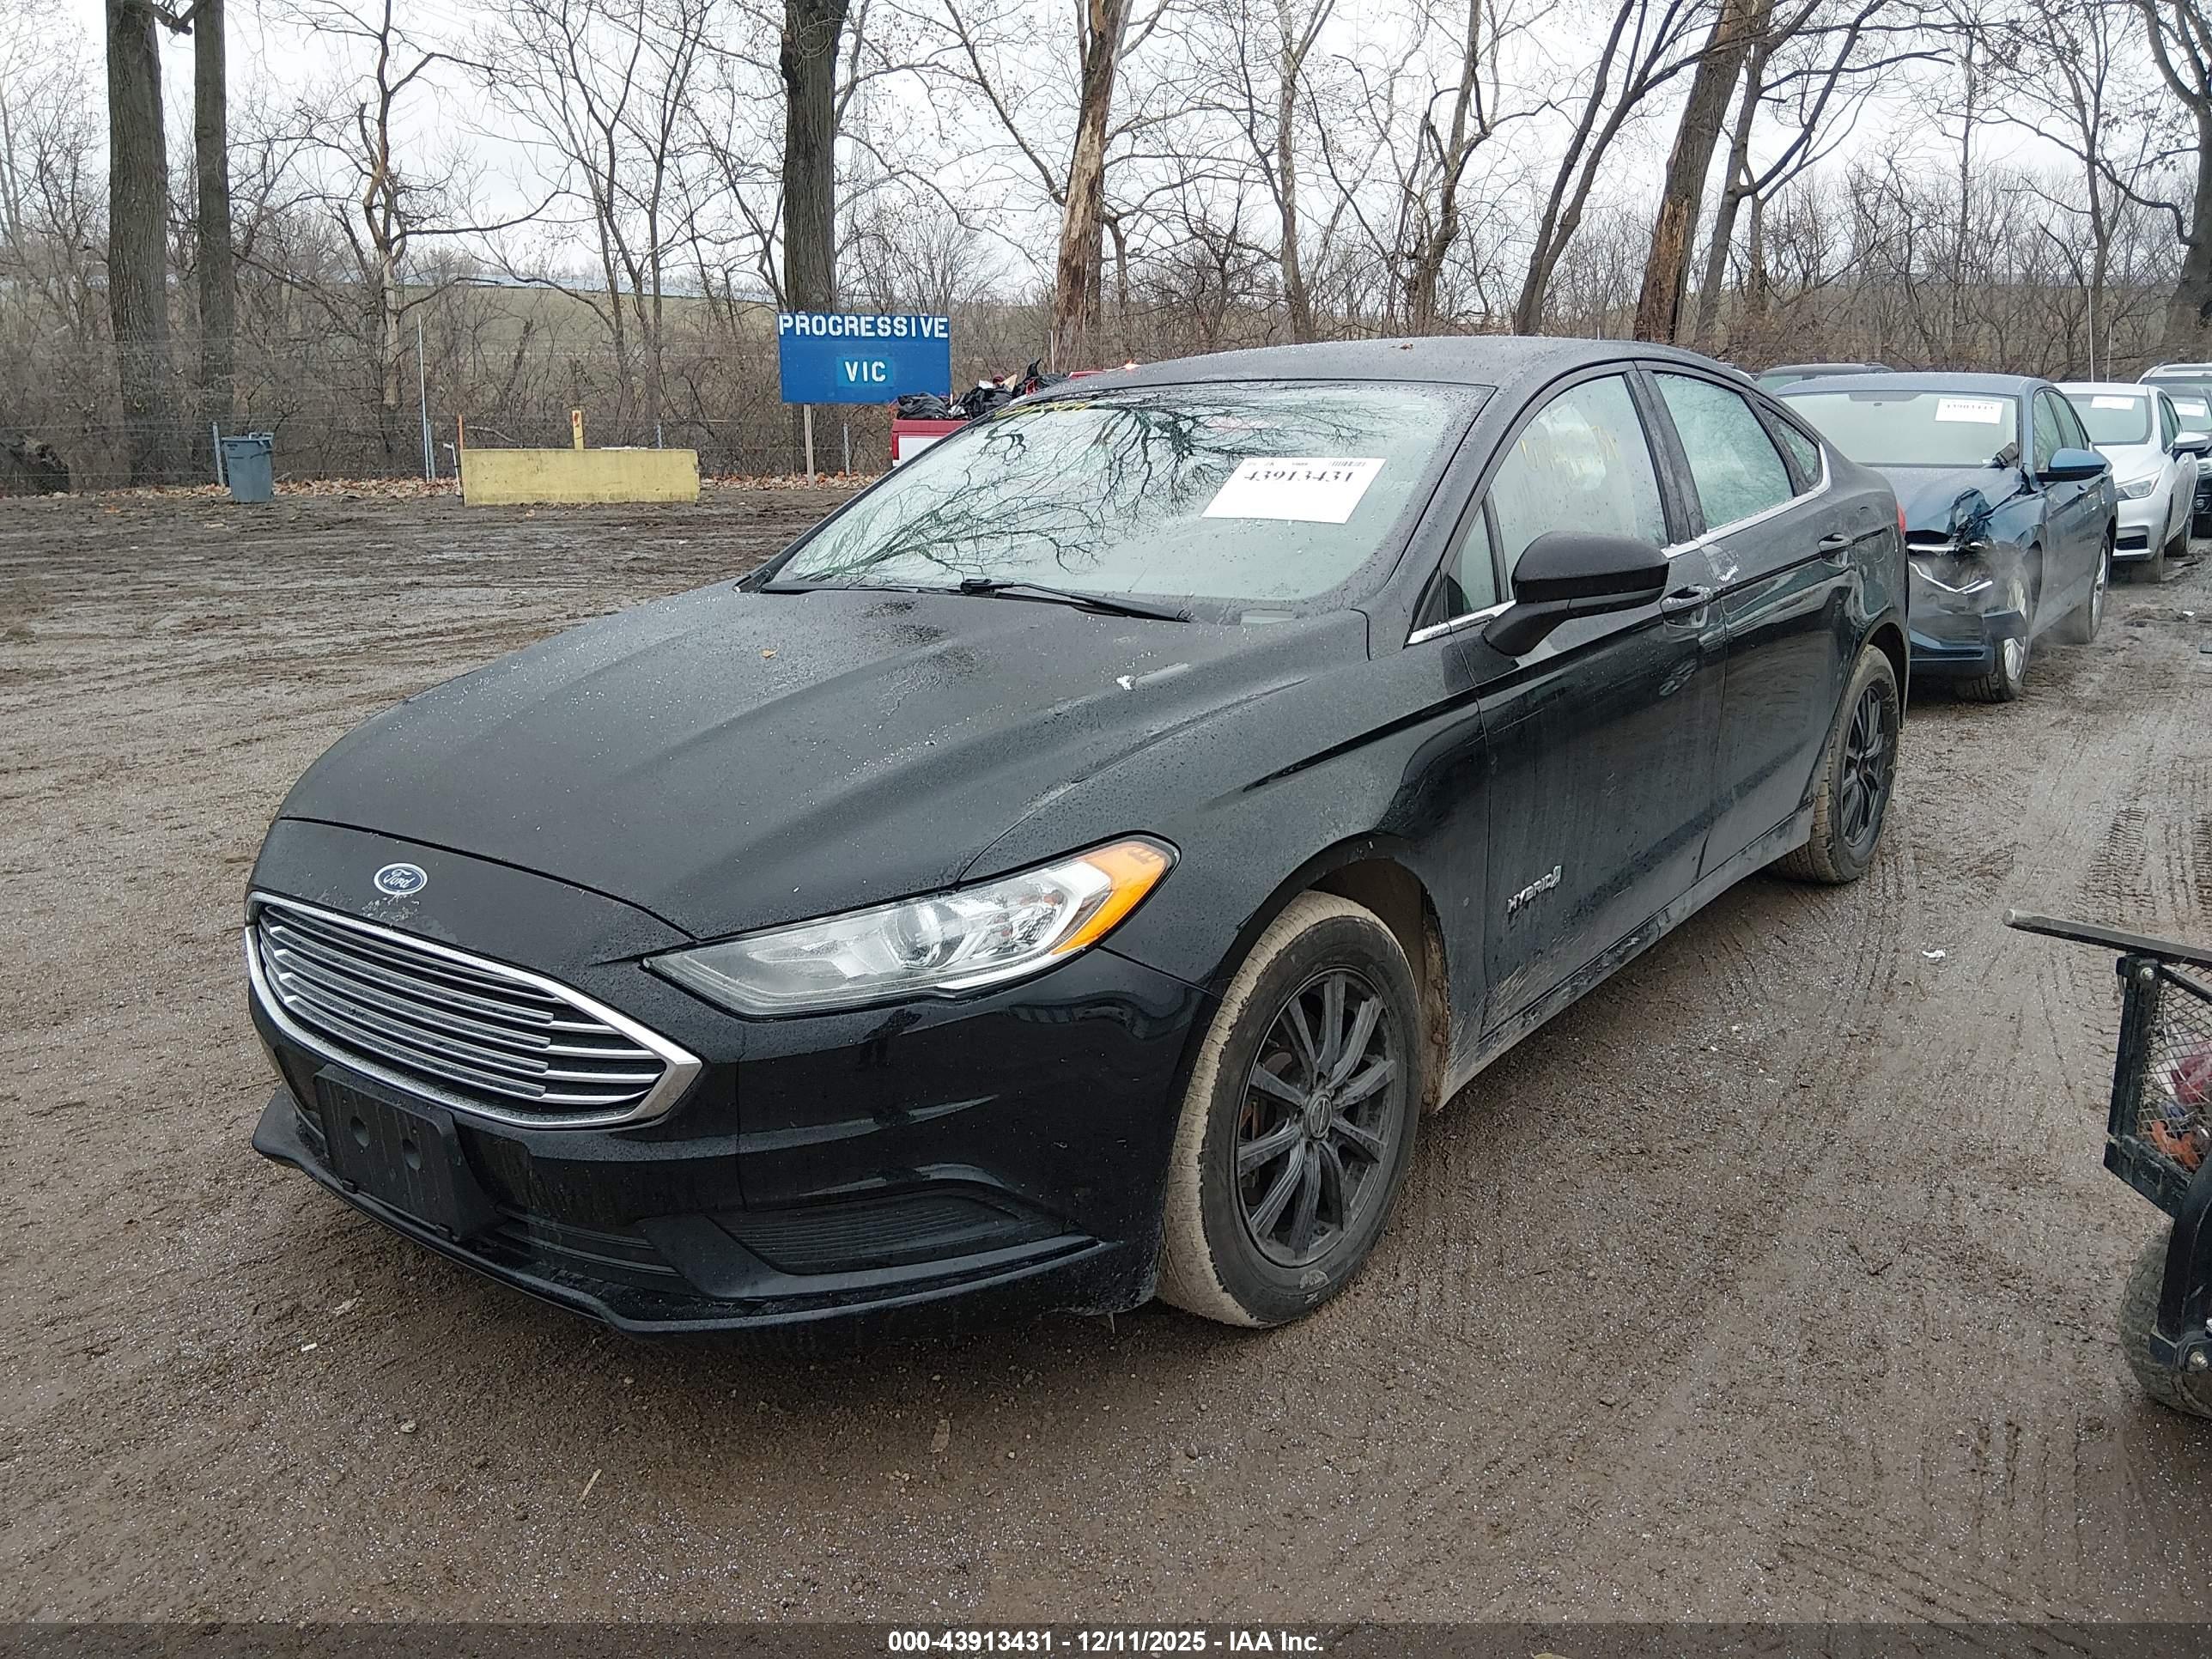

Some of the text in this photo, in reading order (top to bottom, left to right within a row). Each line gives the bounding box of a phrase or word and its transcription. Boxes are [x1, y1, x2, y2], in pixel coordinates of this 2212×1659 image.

[779, 314, 948, 338] PROGRESSIVE
[844, 361, 886, 382] VIC
[1243, 471, 1354, 482] 43913431
[383, 868, 416, 889] Ford
[1507, 872, 1553, 913] HYBRID
